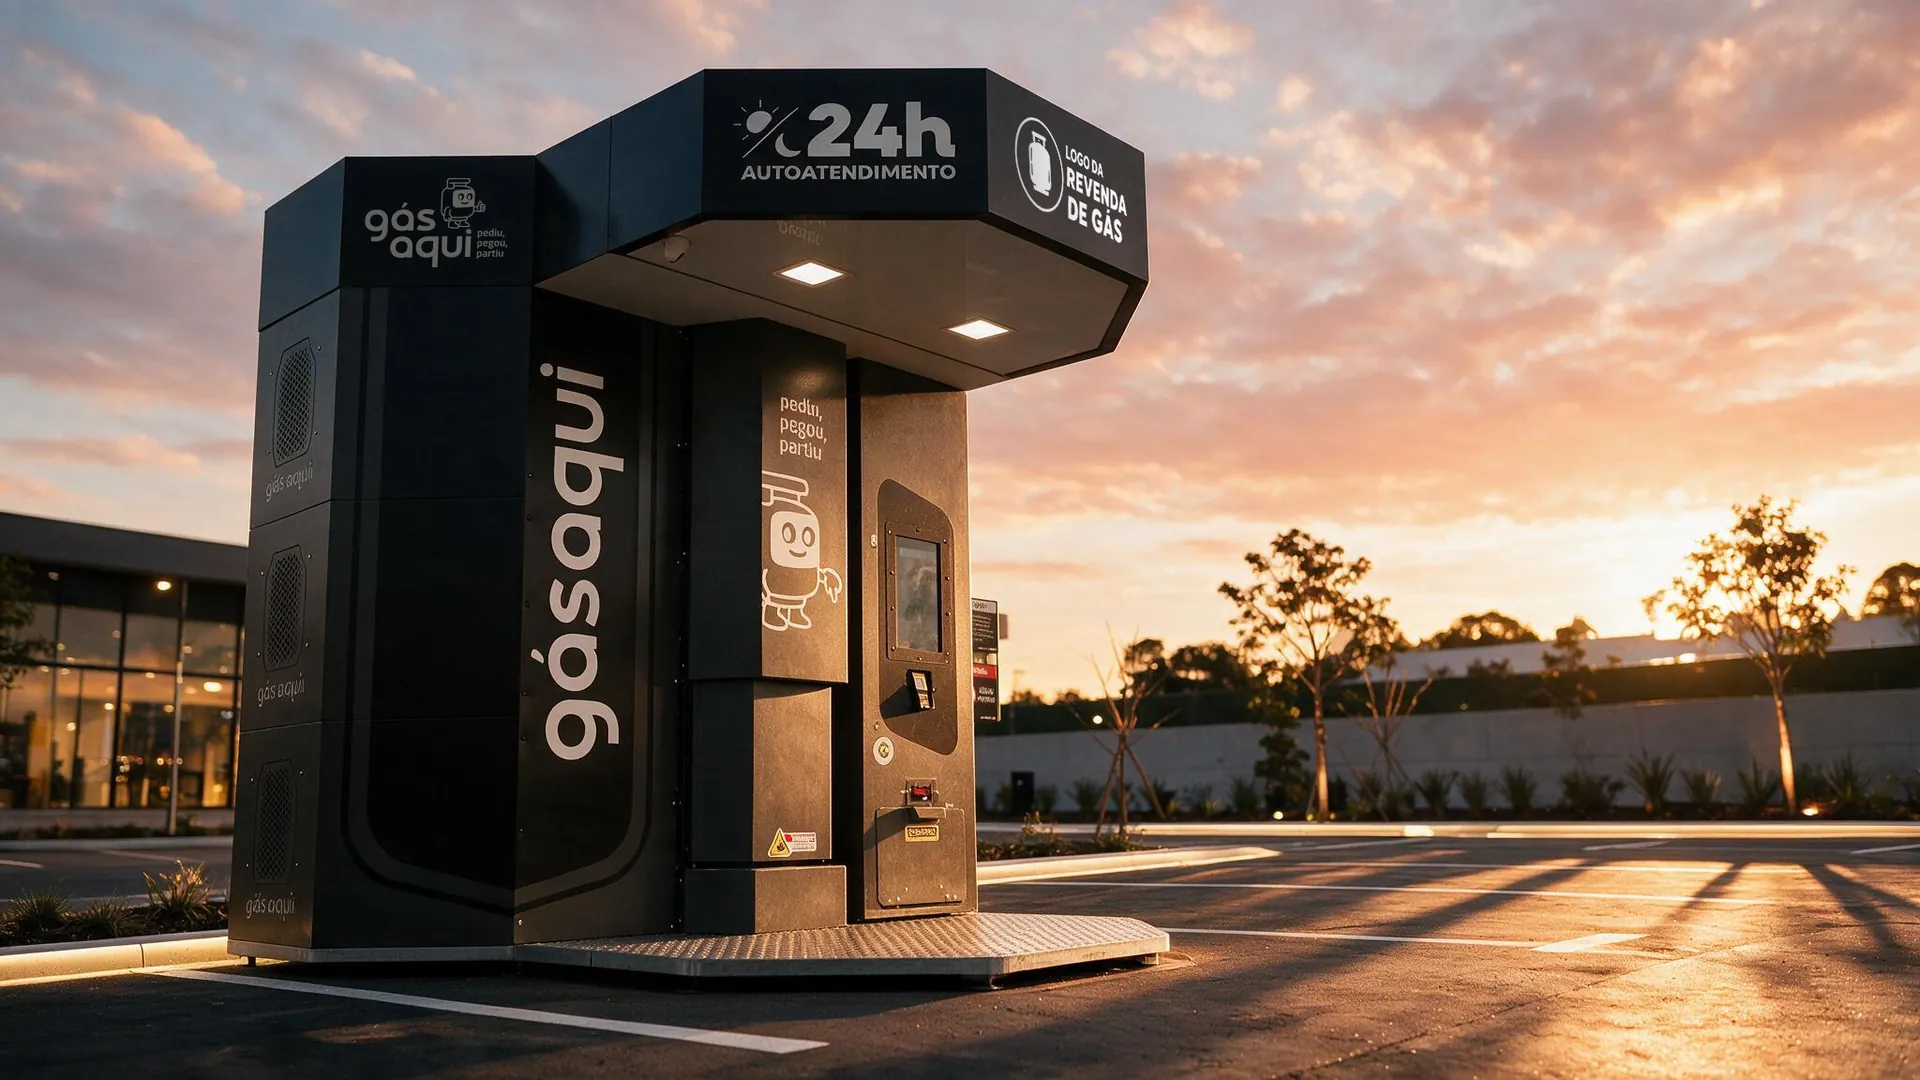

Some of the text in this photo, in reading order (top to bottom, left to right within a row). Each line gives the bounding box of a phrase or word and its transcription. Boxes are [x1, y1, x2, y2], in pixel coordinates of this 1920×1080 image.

[808, 101, 956, 158] 24h
[741, 164, 957, 181] AUTOATENDIMENTO
[1065, 144, 1104, 178] LOGO DA
[1066, 166, 1128, 217] REVENDA
[364, 202, 436, 242] gás
[477, 228, 506, 239] pediu,
[1067, 195, 1123, 244] DE GÁS
[389, 228, 472, 268] aqui
[476, 240, 508, 250] pegou,
[476, 249, 504, 260] partiu
[780, 417, 827, 444] pegou,
